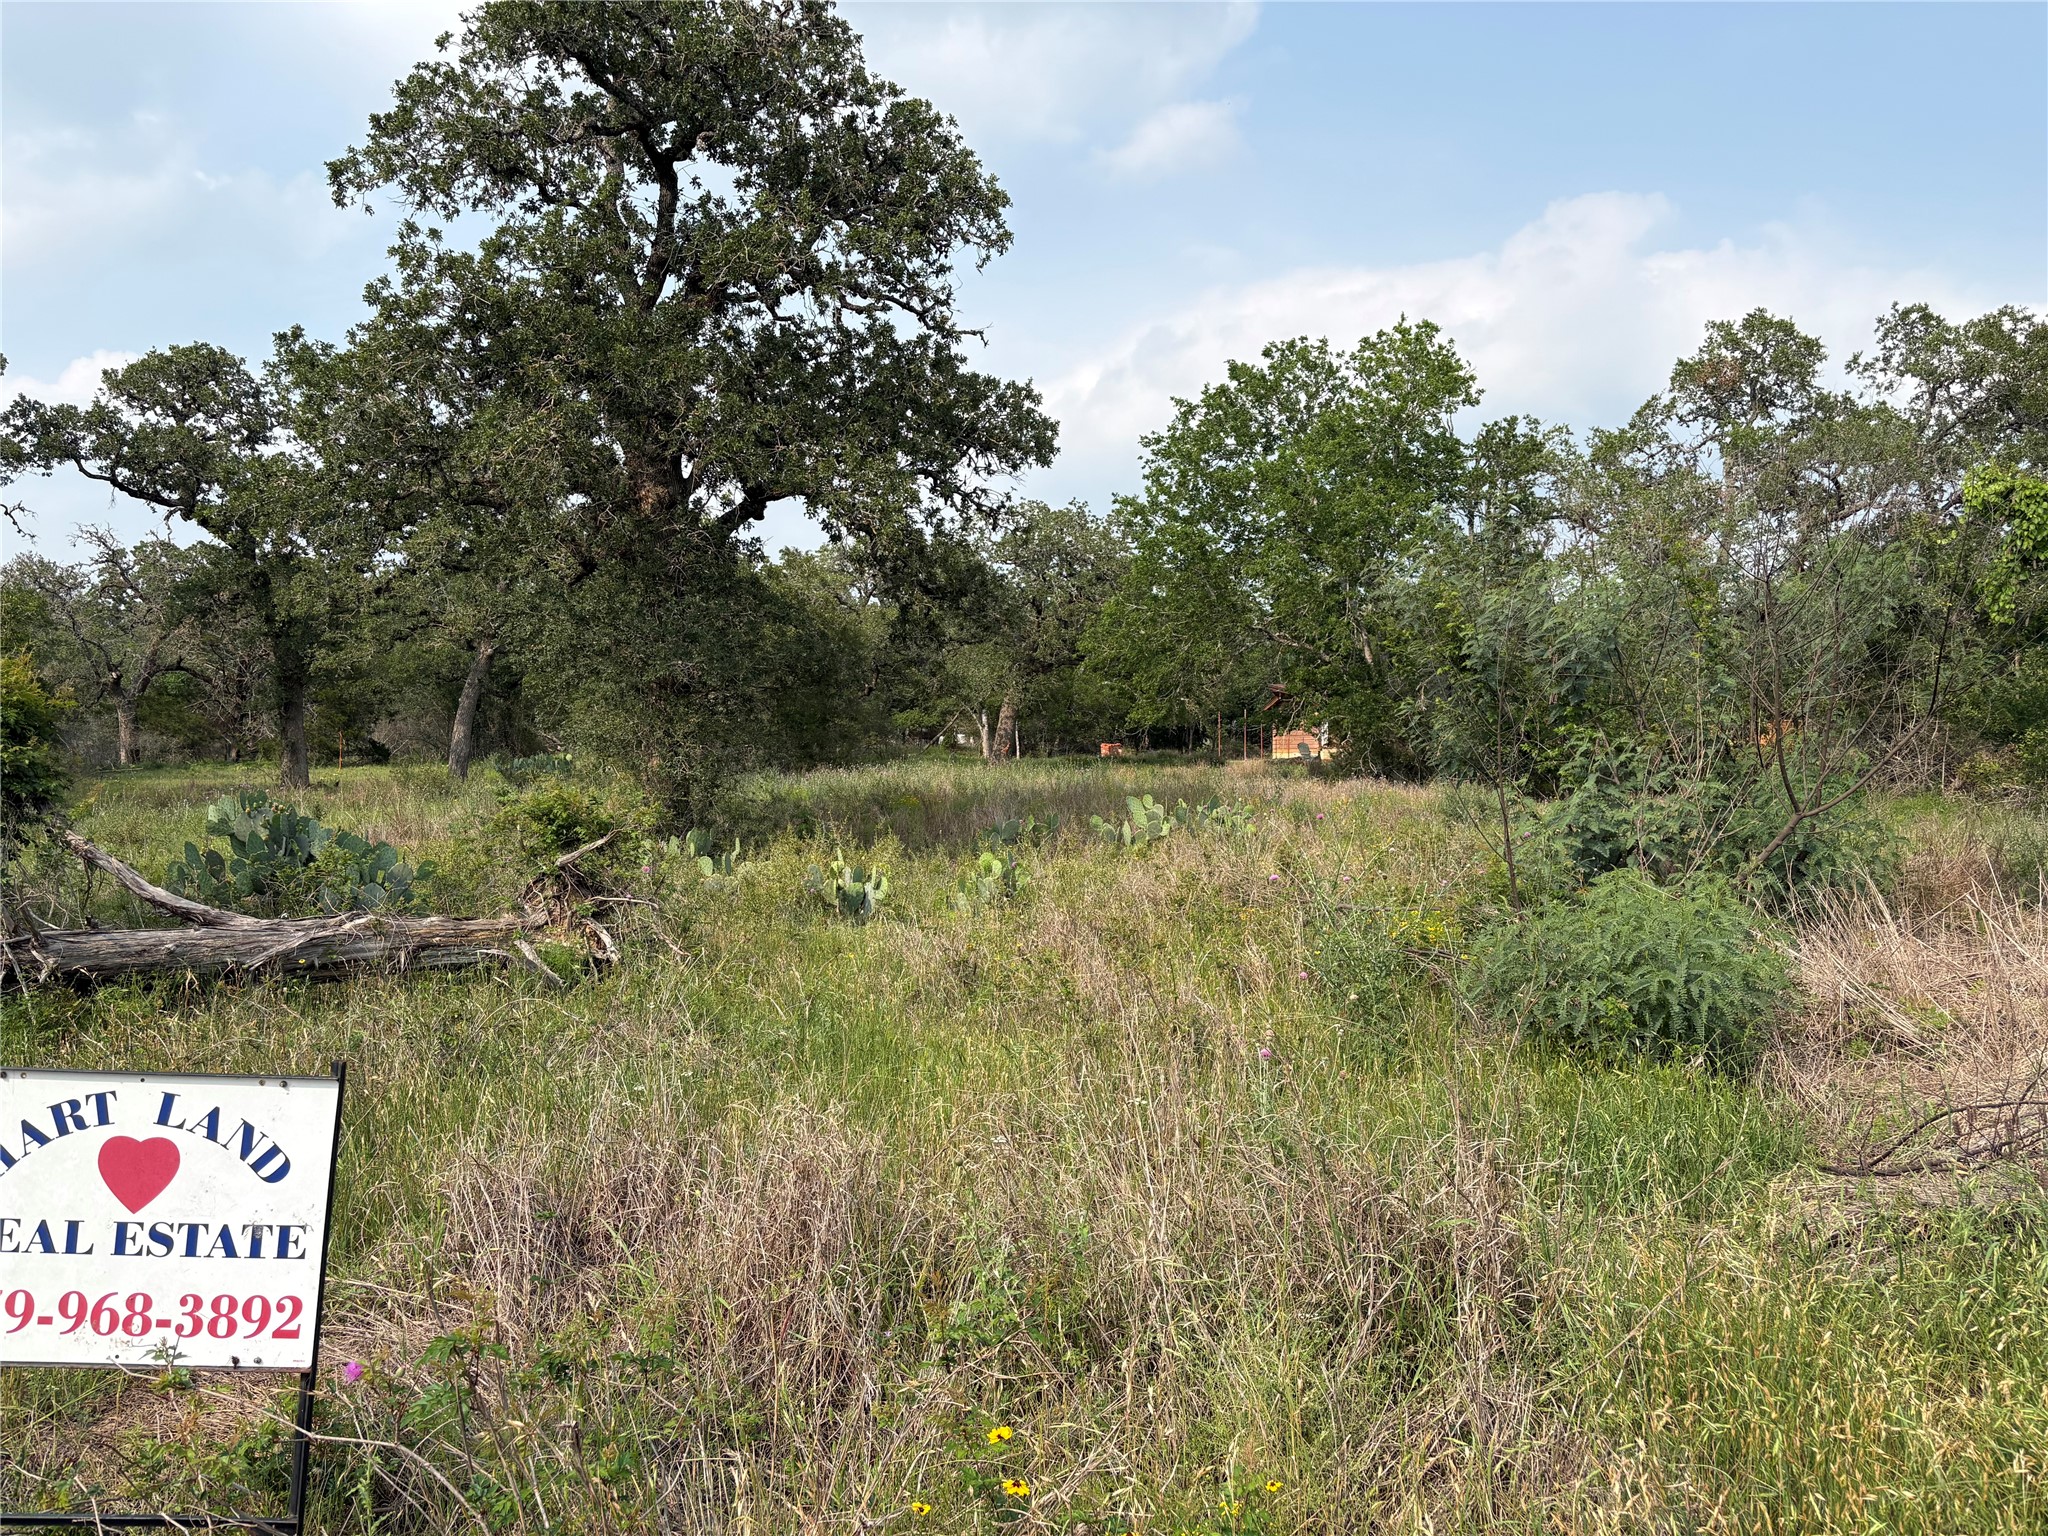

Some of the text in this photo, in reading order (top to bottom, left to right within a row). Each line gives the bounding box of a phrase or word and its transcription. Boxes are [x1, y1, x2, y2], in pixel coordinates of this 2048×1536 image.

[153, 1091, 291, 1183] LAND
[110, 1221, 307, 1259] ESTATE
[0, 1289, 303, 1339] 9-968-3892
